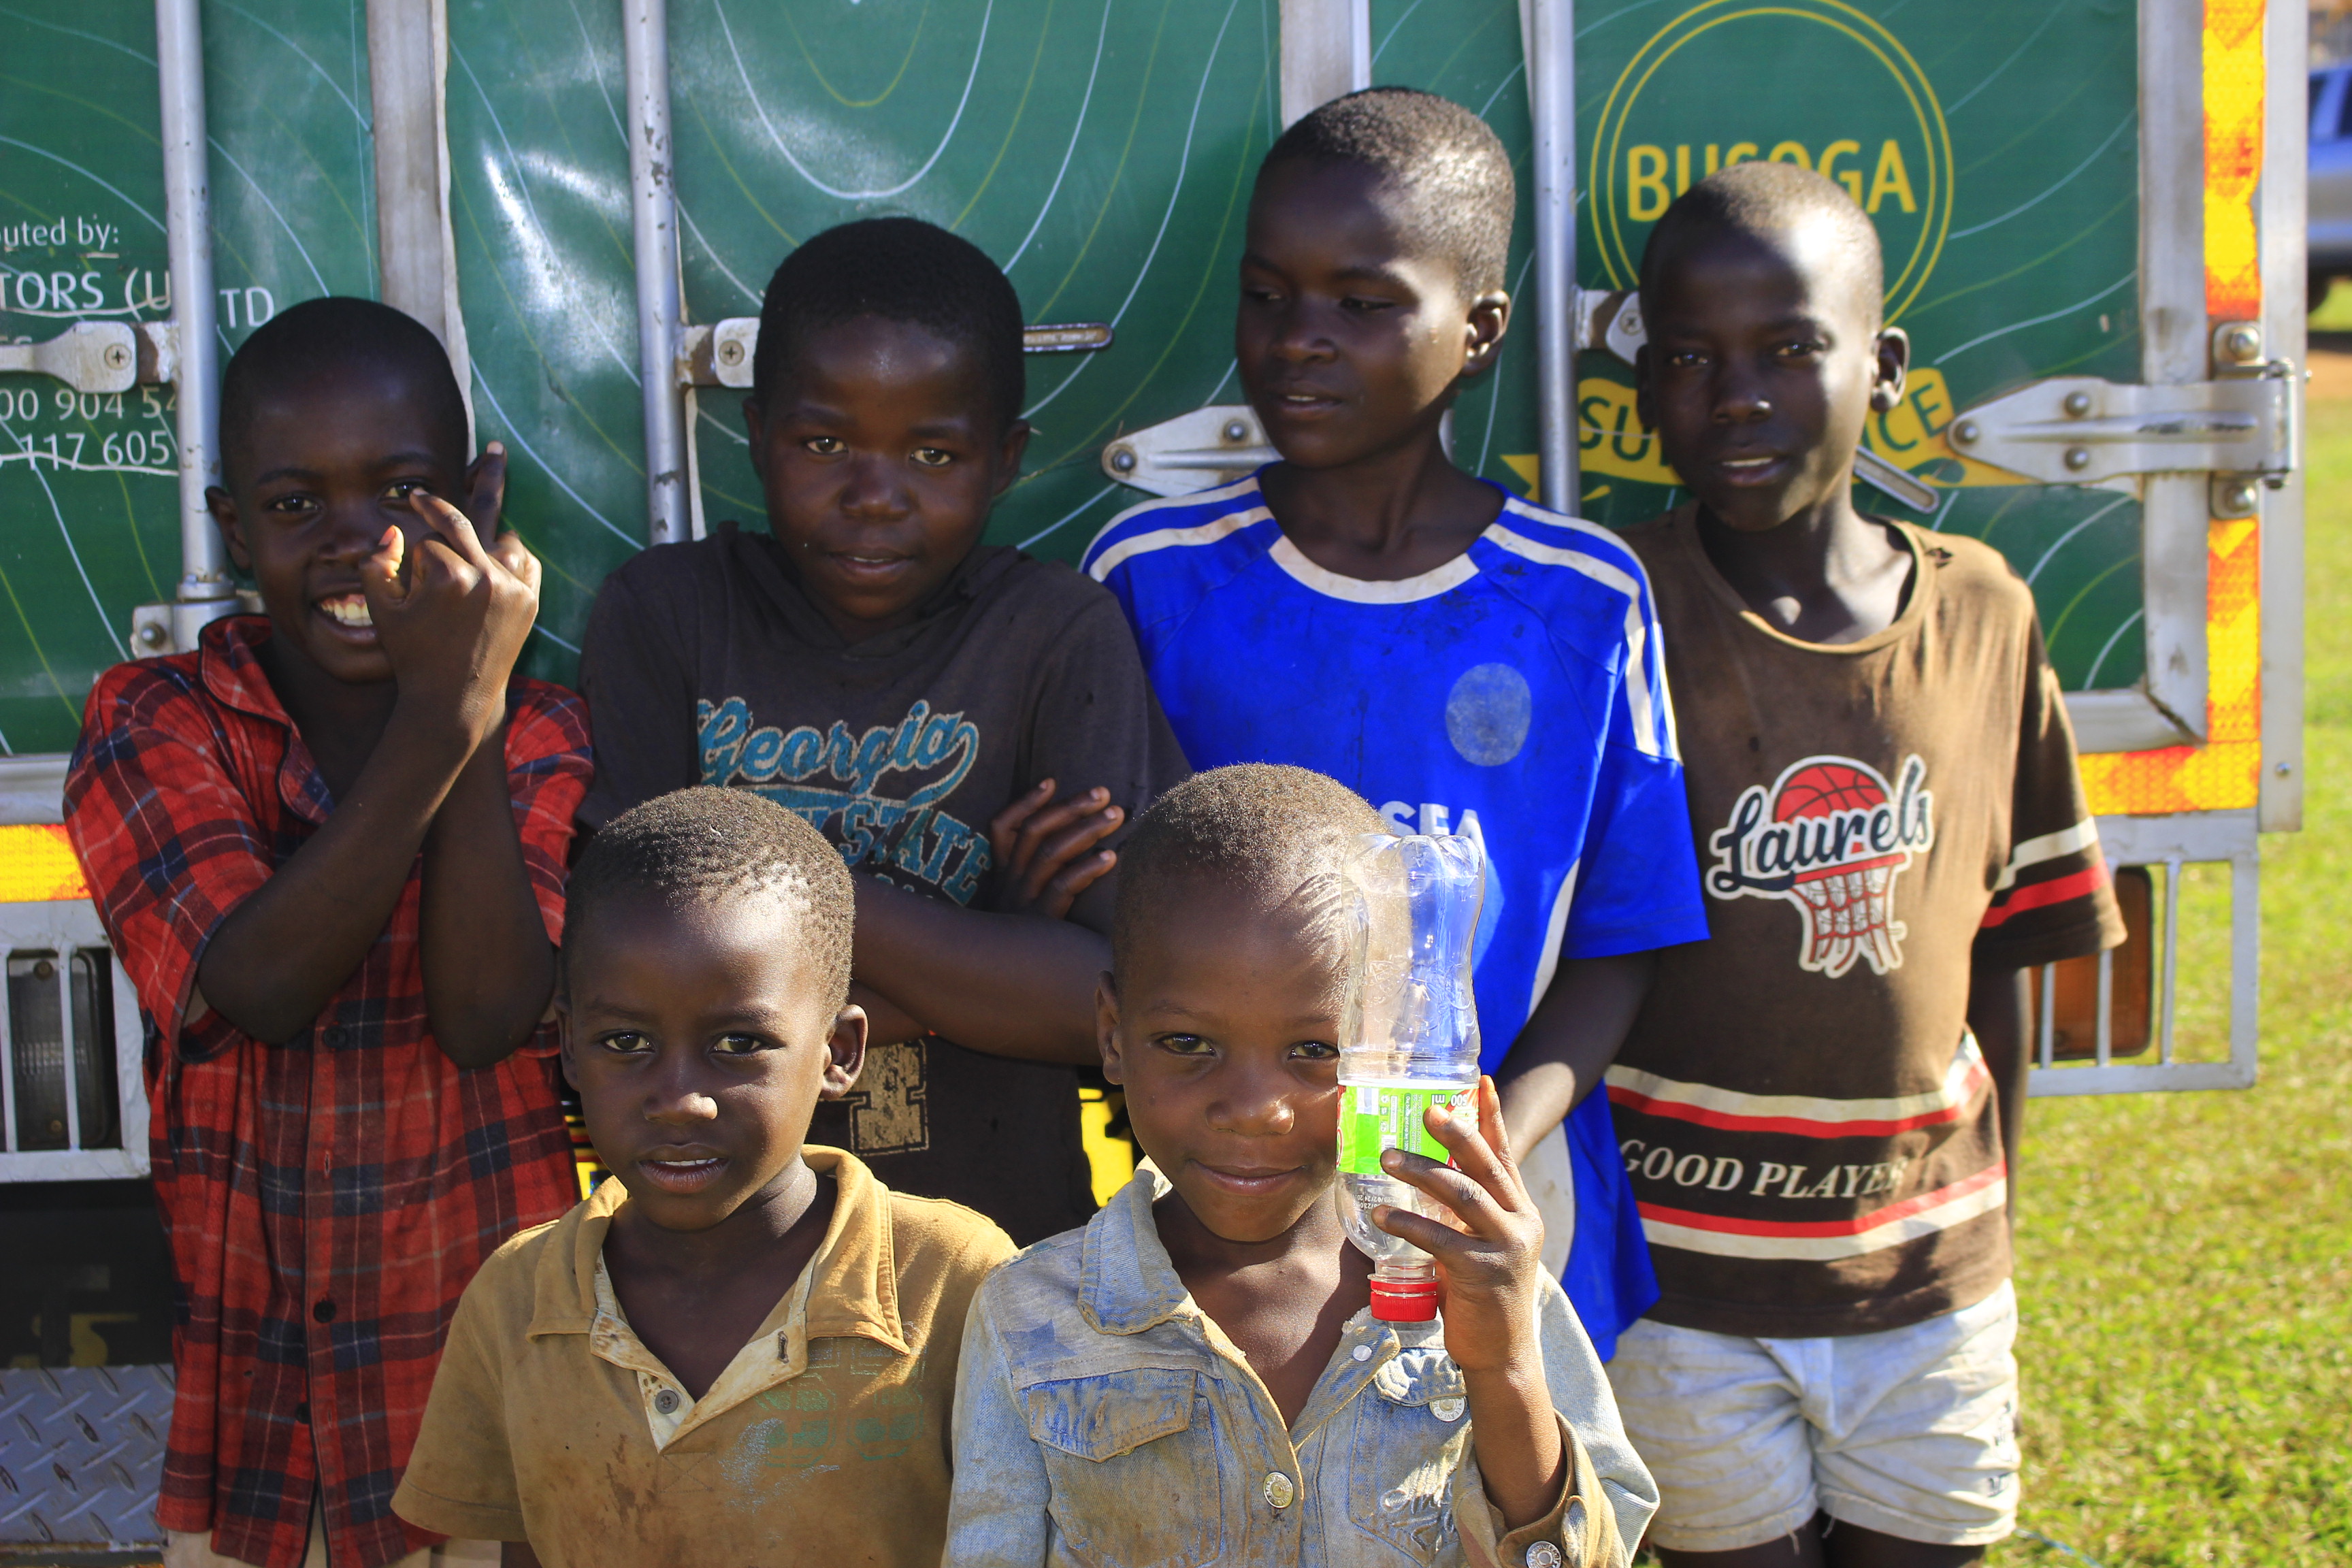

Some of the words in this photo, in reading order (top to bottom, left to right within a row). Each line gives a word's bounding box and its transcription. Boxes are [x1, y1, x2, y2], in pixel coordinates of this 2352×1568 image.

[0, 216, 66, 247] uted
[219, 287, 275, 329] TD
[55, 389, 124, 420] 904
[103, 430, 170, 466] 605
[698, 696, 979, 798] Georgia
[1710, 756, 1931, 895] Laurels
[1431, 1094, 1446, 1105] ml
[1450, 1094, 1467, 1107] 500
[1619, 1139, 1744, 1191] GOOD
